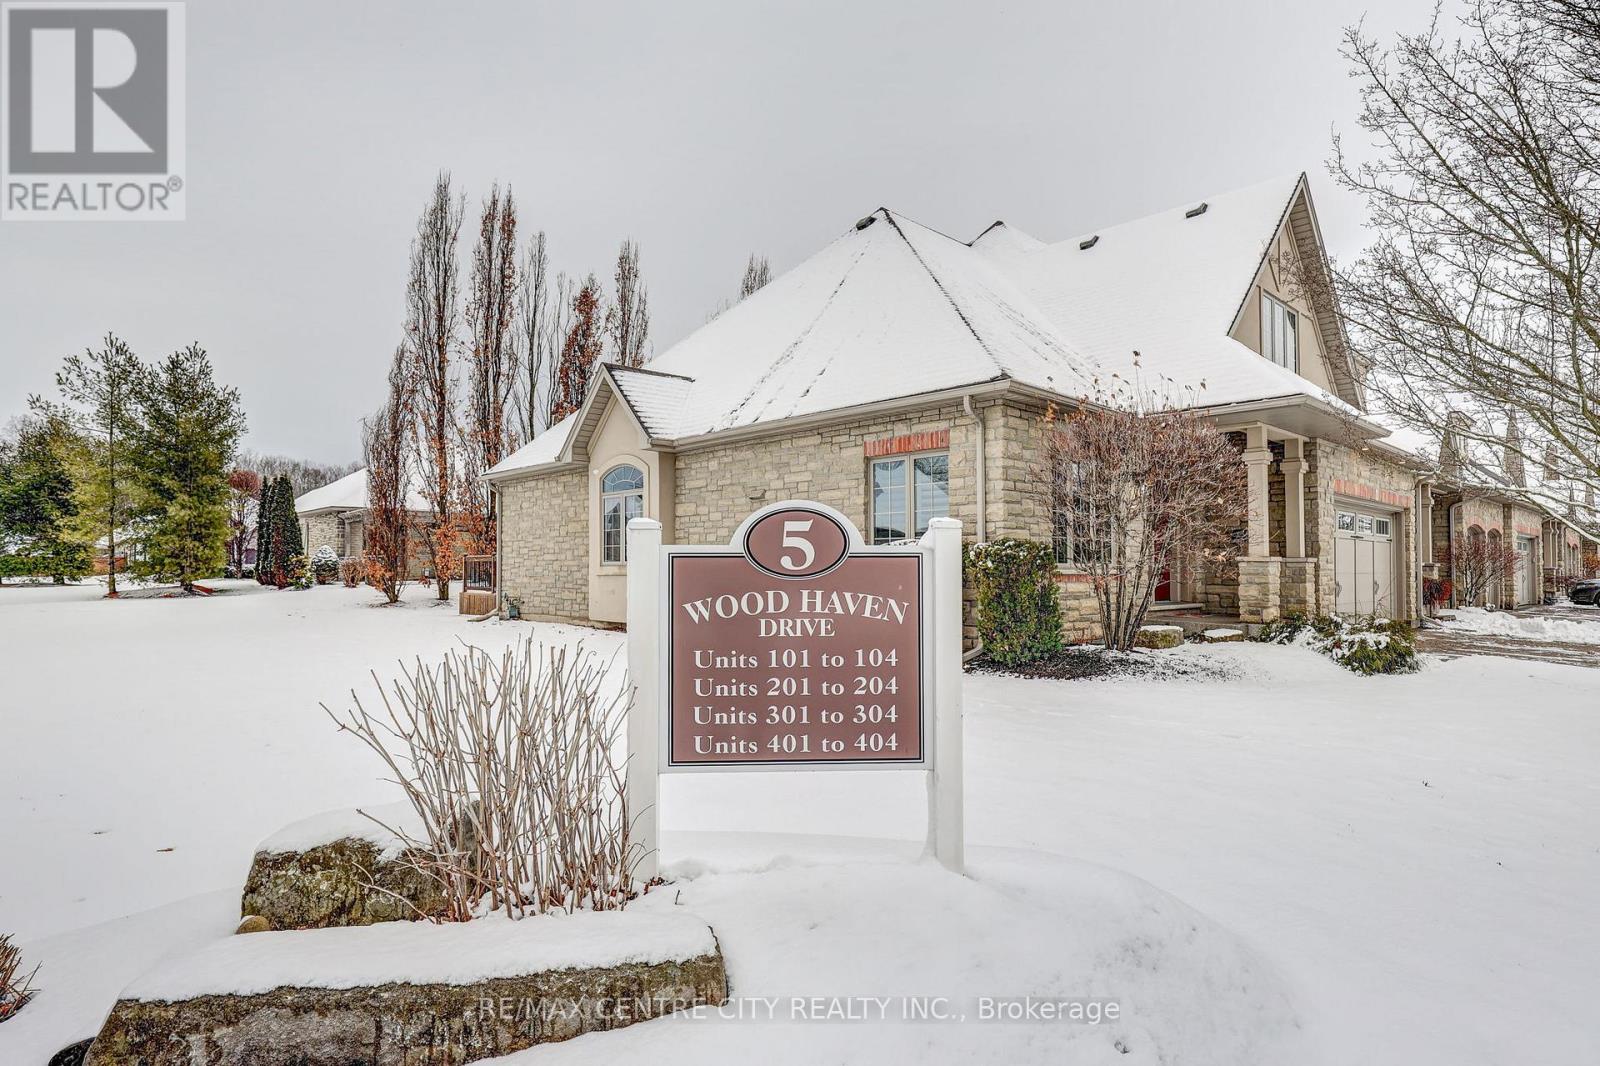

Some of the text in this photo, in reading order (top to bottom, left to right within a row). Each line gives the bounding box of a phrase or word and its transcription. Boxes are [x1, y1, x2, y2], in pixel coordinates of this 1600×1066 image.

[780, 518, 815, 571] 5
[682, 589, 909, 625] WOOD HAVEN
[759, 618, 835, 637] DRIVE
[693, 648, 899, 669] Units 101 to 104
[693, 676, 899, 697] Units 201 to 204
[693, 704, 899, 725] Units 301 to 304
[693, 732, 899, 753] Units 401 to 404
